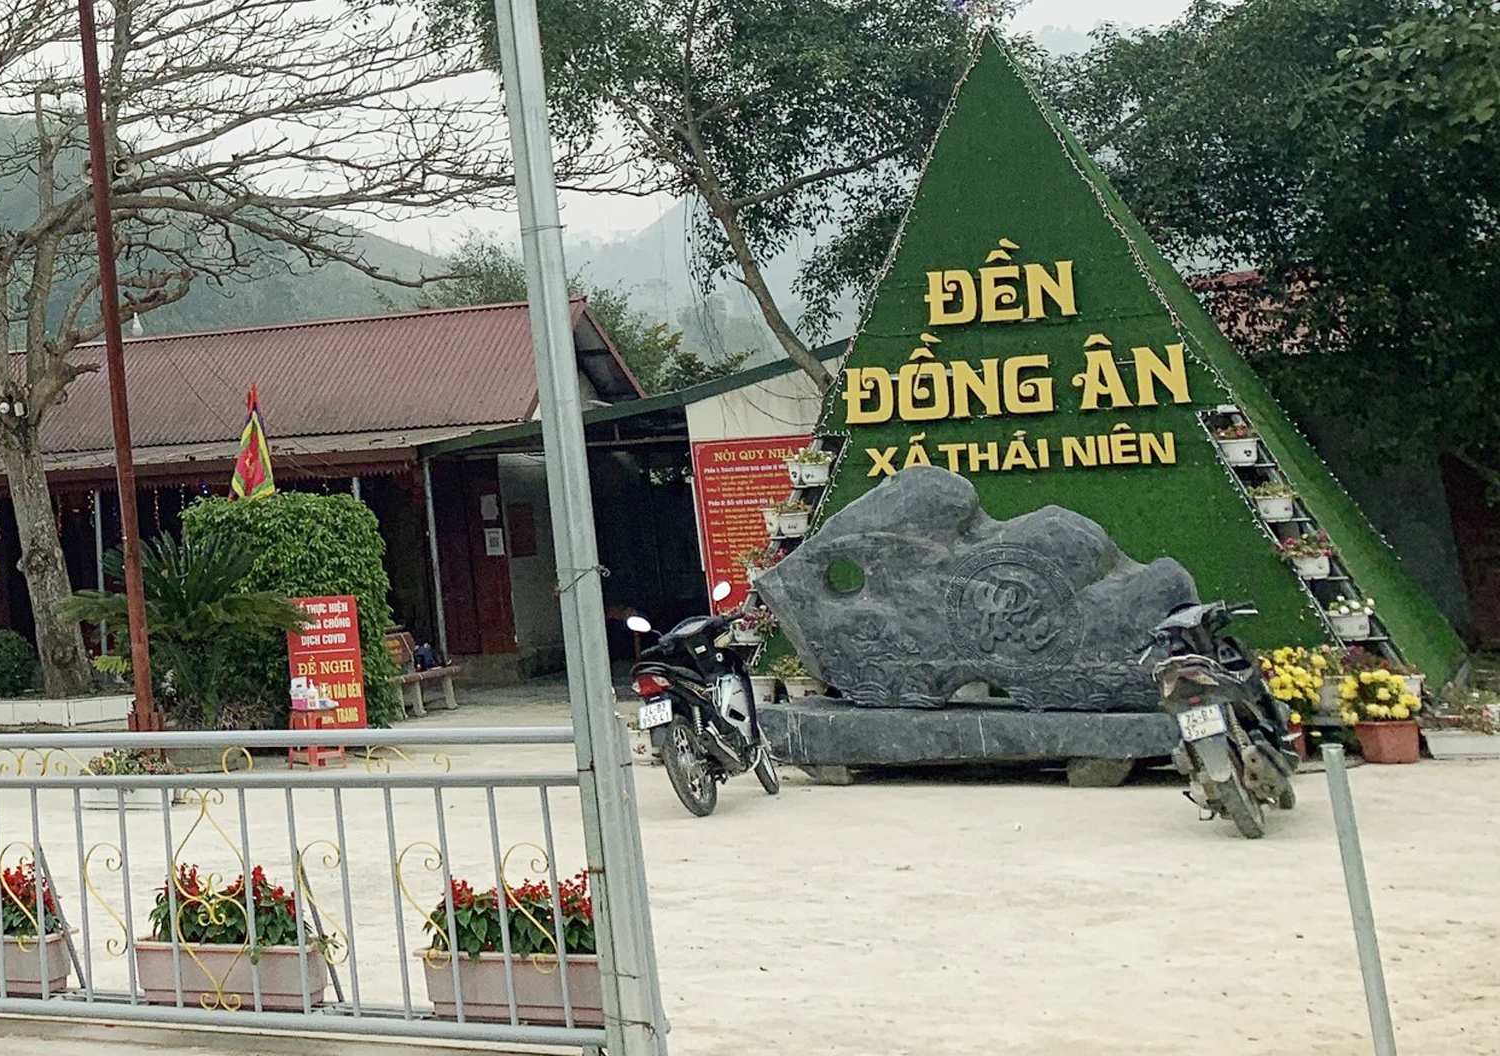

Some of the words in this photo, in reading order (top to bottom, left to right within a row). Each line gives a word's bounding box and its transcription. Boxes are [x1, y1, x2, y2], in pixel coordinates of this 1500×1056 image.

[924, 237, 1079, 326] ĐỀN
[842, 333, 1054, 424] ĐỒNG
[1072, 333, 1192, 410] ÂN
[714, 449, 736, 462] NỘI
[739, 449, 764, 461] QUY
[865, 431, 933, 477] XÃ
[938, 430, 1050, 473] THÁI
[1062, 422, 1176, 467] NIÊN
[306, 602, 327, 616] THỰC
[328, 600, 348, 614] HIỆN
[323, 613, 350, 629] CHỐNG
[301, 635, 320, 648] DỊCH
[322, 633, 346, 645] COVID
[297, 655, 317, 676] ĐỀ
[320, 659, 355, 676] NGHỊ
[336, 707, 359, 723] TRANG
